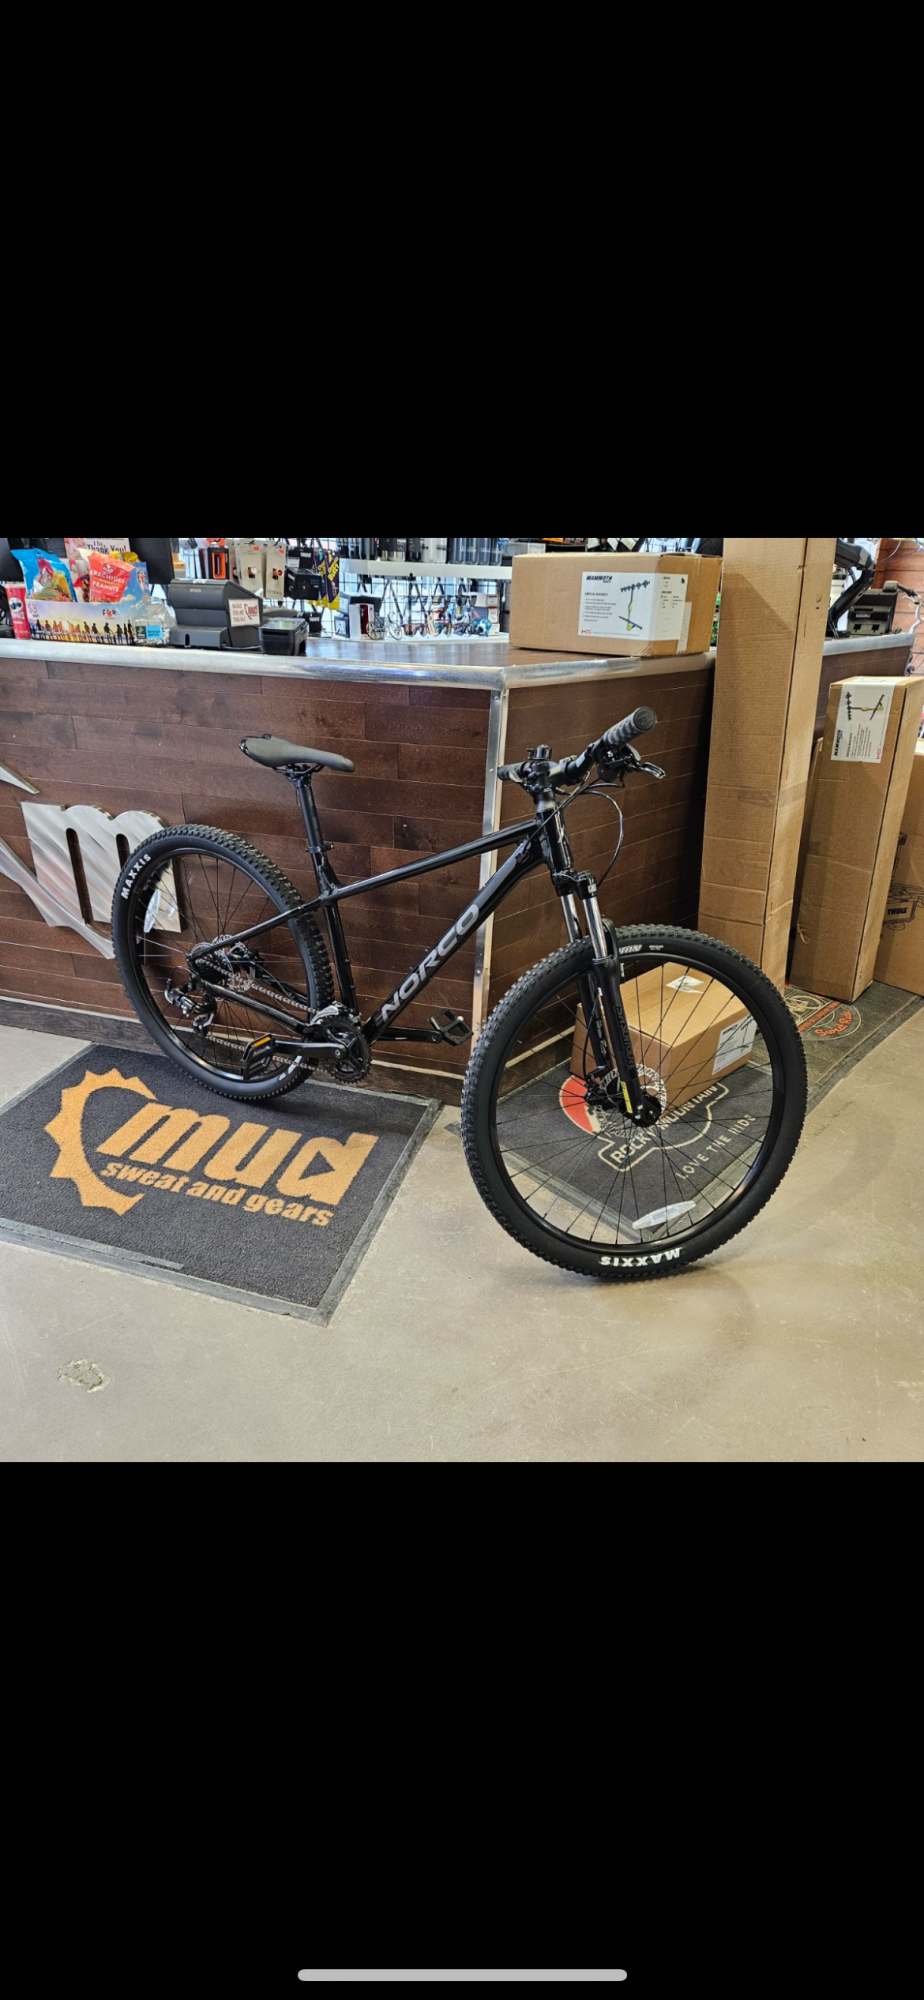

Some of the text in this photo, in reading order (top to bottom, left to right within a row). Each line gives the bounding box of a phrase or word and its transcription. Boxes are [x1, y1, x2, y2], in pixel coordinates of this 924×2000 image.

[92, 580, 119, 592] PEANUTS
[121, 852, 151, 899] MAXXIS
[887, 907, 907, 915] THULE
[380, 903, 480, 1022] NORCO
[96, 1102, 380, 1206] mud
[675, 1114, 756, 1179] LOVE THE RIDE
[101, 1160, 335, 1227] sweat and gears
[599, 1247, 682, 1267] MAXXIS
